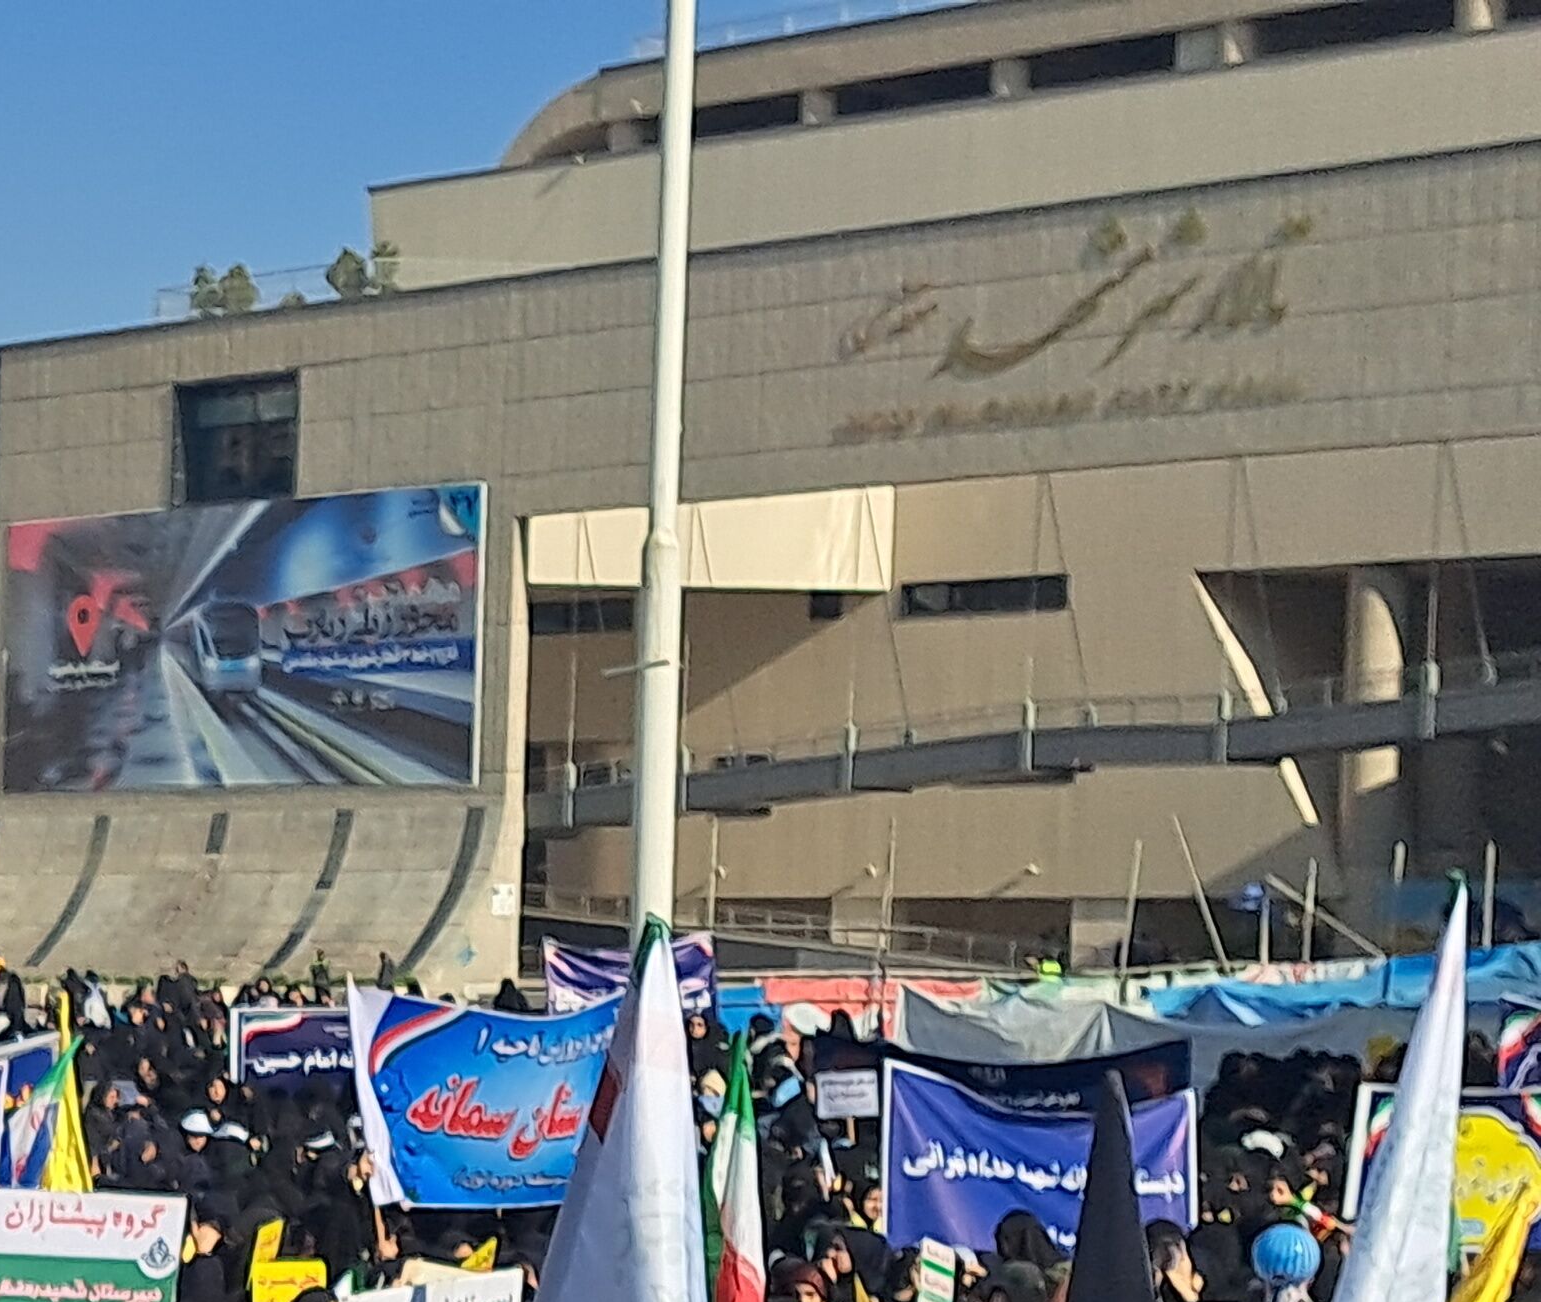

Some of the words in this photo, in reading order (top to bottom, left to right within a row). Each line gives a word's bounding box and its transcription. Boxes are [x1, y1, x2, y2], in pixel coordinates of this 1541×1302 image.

[304, 1047, 338, 1077] امام
[406, 1073, 516, 1140] سمانه
[509, 1081, 581, 1160] ستان
[112, 1204, 166, 1240] گروه
